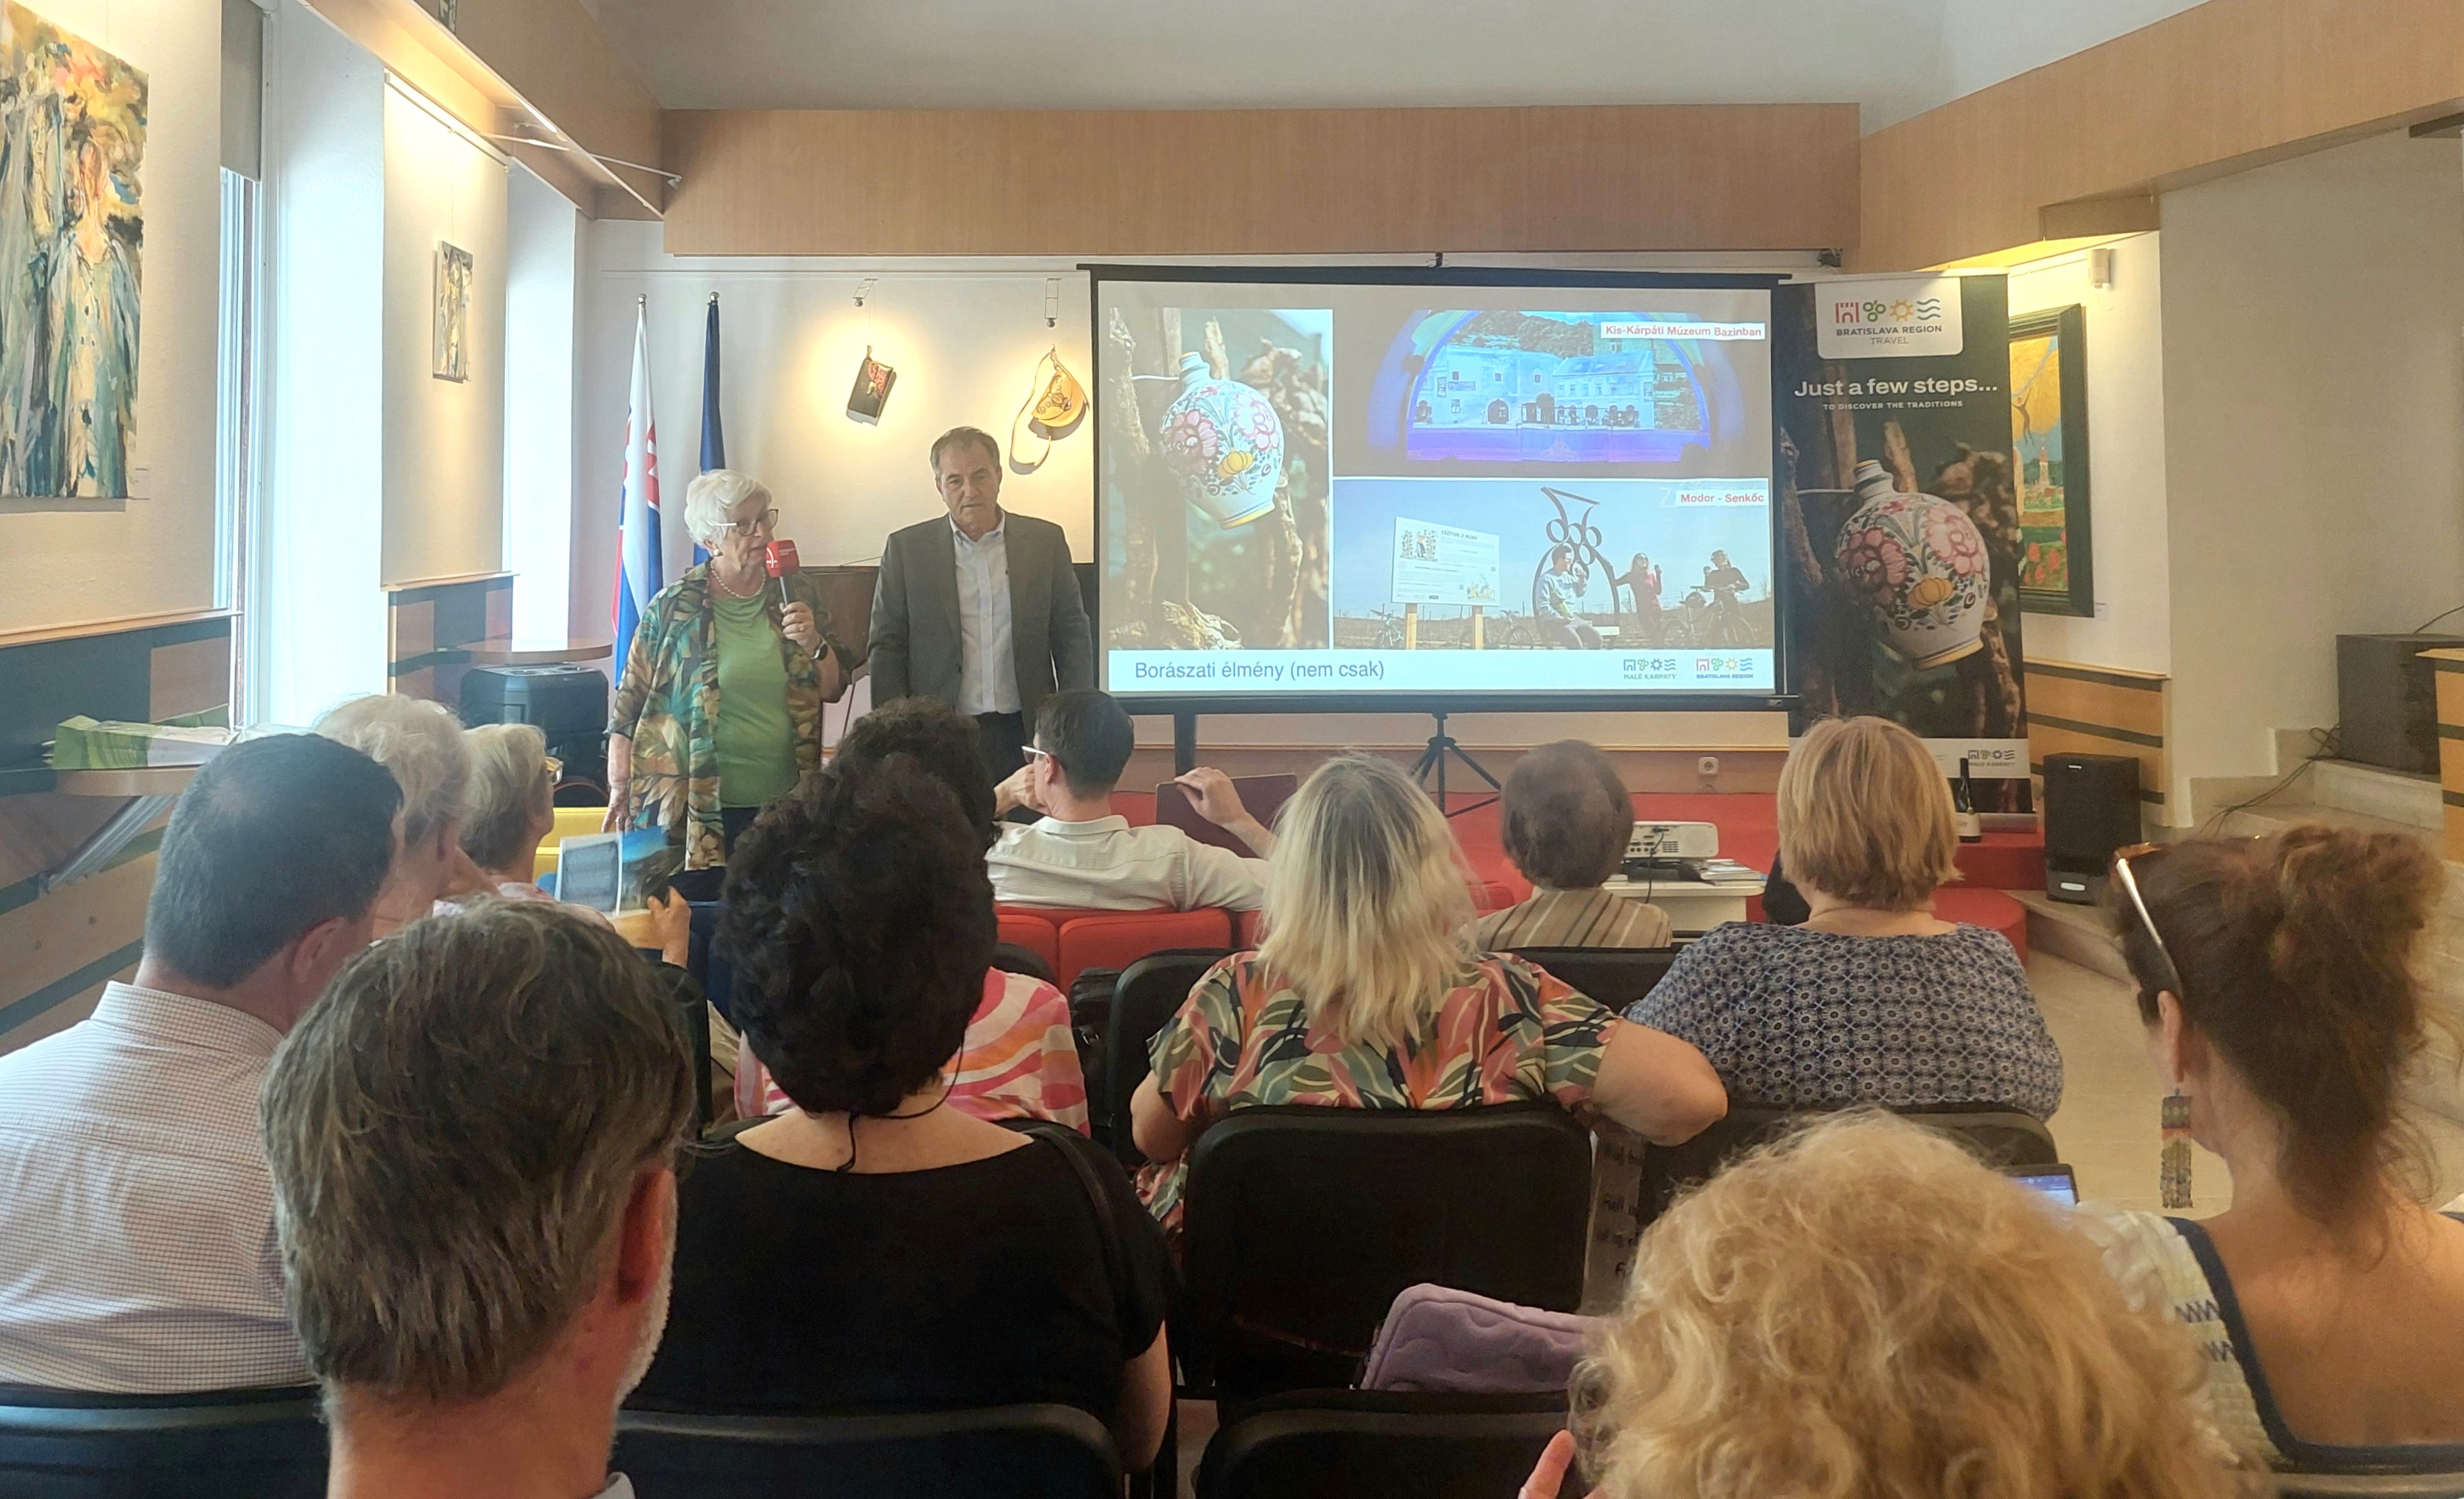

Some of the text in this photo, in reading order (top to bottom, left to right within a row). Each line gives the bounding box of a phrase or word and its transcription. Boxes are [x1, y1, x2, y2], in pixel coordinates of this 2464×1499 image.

[1605, 325, 1762, 337] Kis-Kárpáti Múzeum Bazinban
[1836, 325, 1943, 336] BRATISLAVA REGION
[1870, 336, 1910, 345] TRAVEL
[1793, 377, 1998, 397] Just a few steps...
[1680, 493, 1715, 503] Modor
[1134, 660, 1385, 681] Borászati élmény (nem csak)
